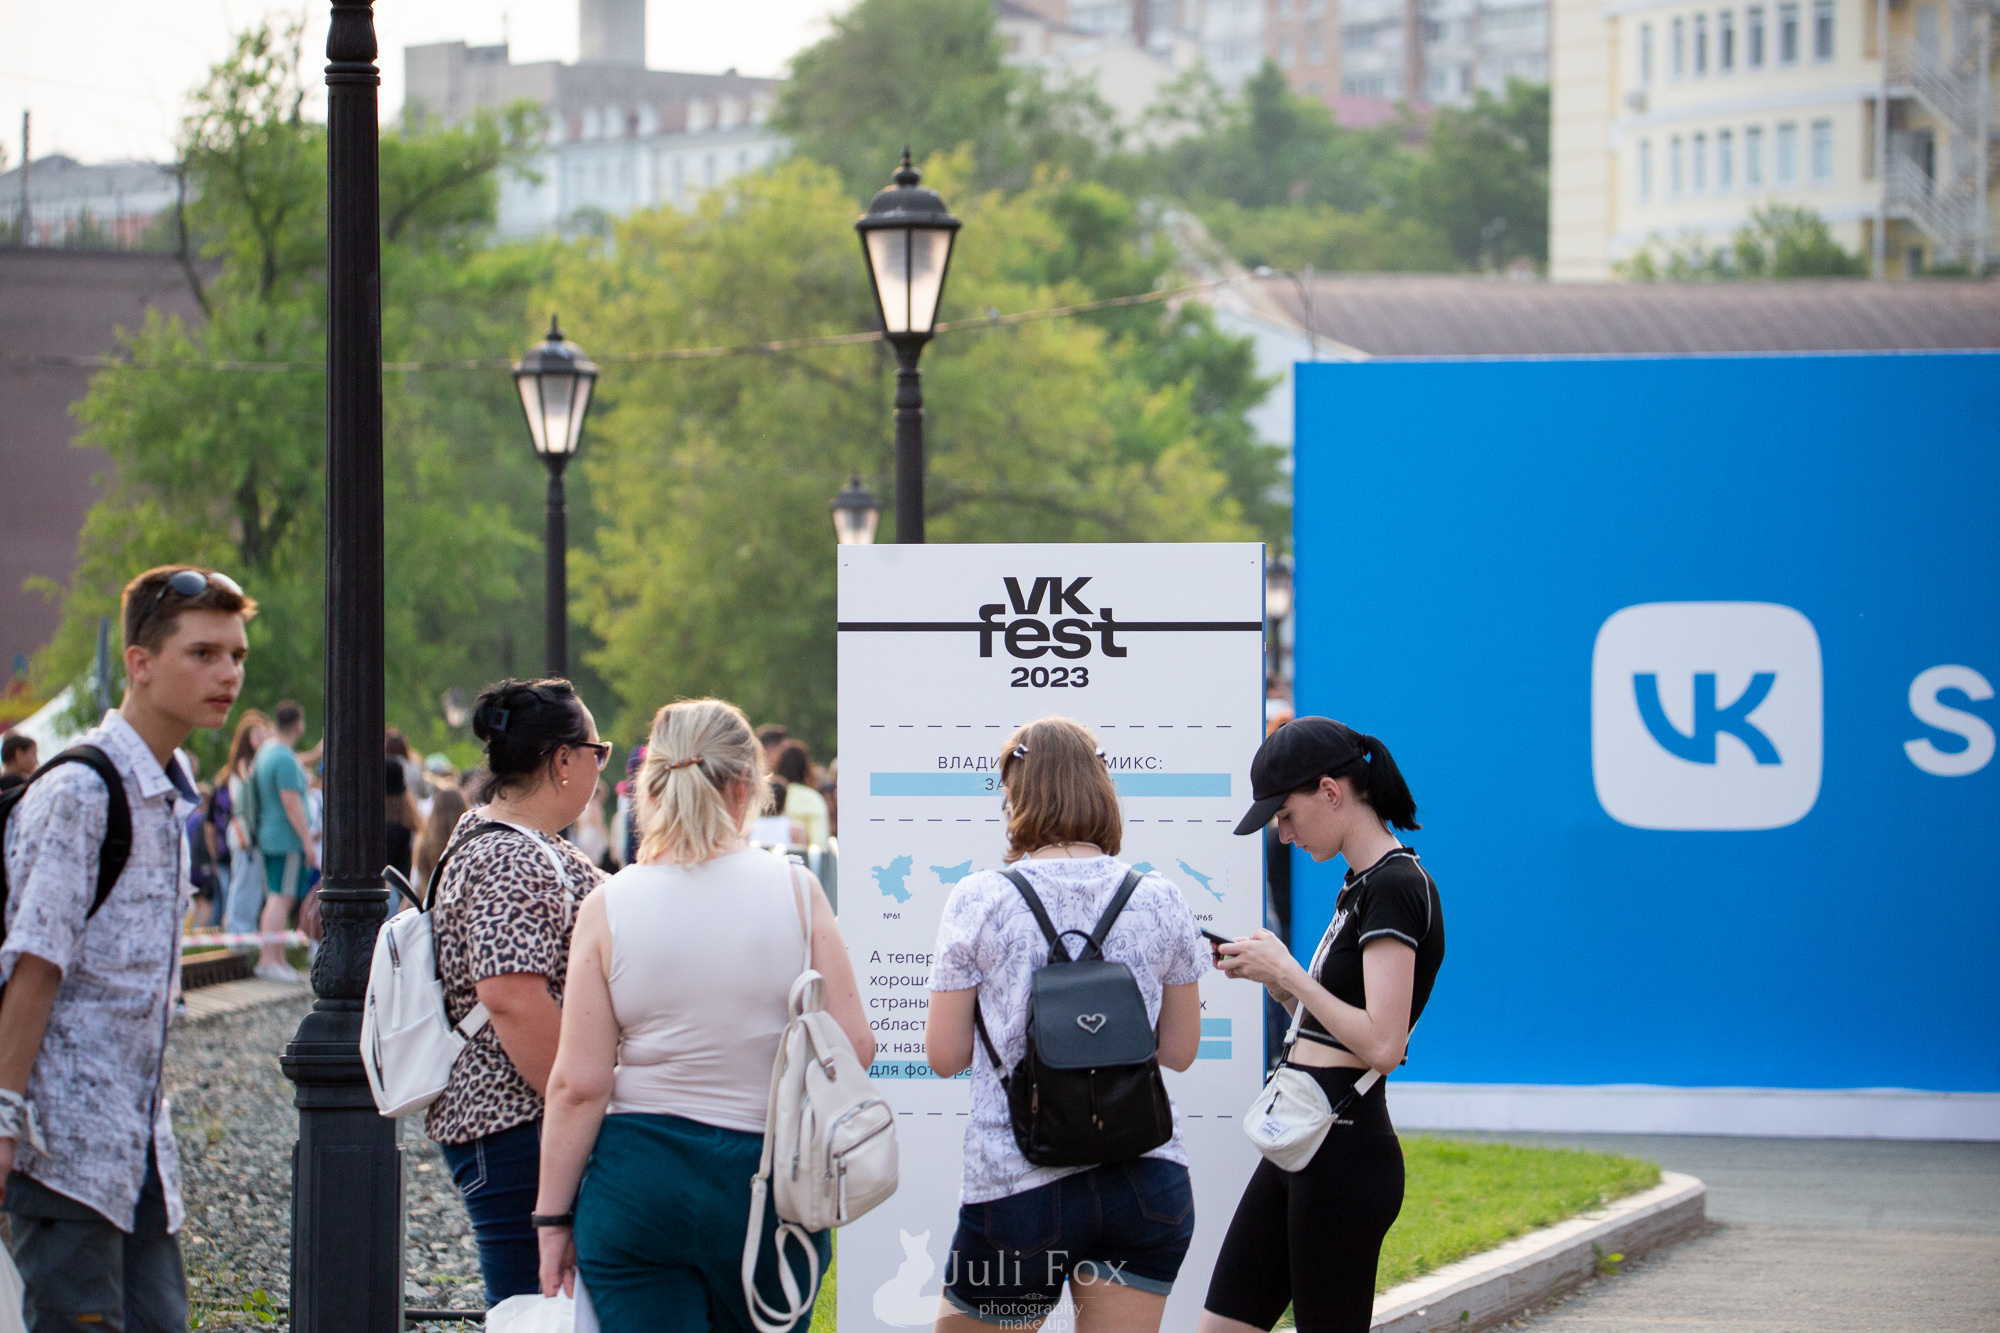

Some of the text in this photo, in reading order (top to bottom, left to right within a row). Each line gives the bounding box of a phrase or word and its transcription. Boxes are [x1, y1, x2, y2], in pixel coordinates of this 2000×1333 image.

[1002, 576, 1095, 615] VK
[978, 603, 1128, 660] fest
[1010, 666, 1089, 688] 2023
[1631, 671, 1783, 767] VK
[938, 756, 1163, 771] ВЛАДИ МИКС:
[869, 950, 934, 967] А тепер
[869, 998, 929, 1012] страны
[869, 1017, 926, 1031] област
[893, 1043, 927, 1053] назв
[869, 1065, 899, 1078] для
